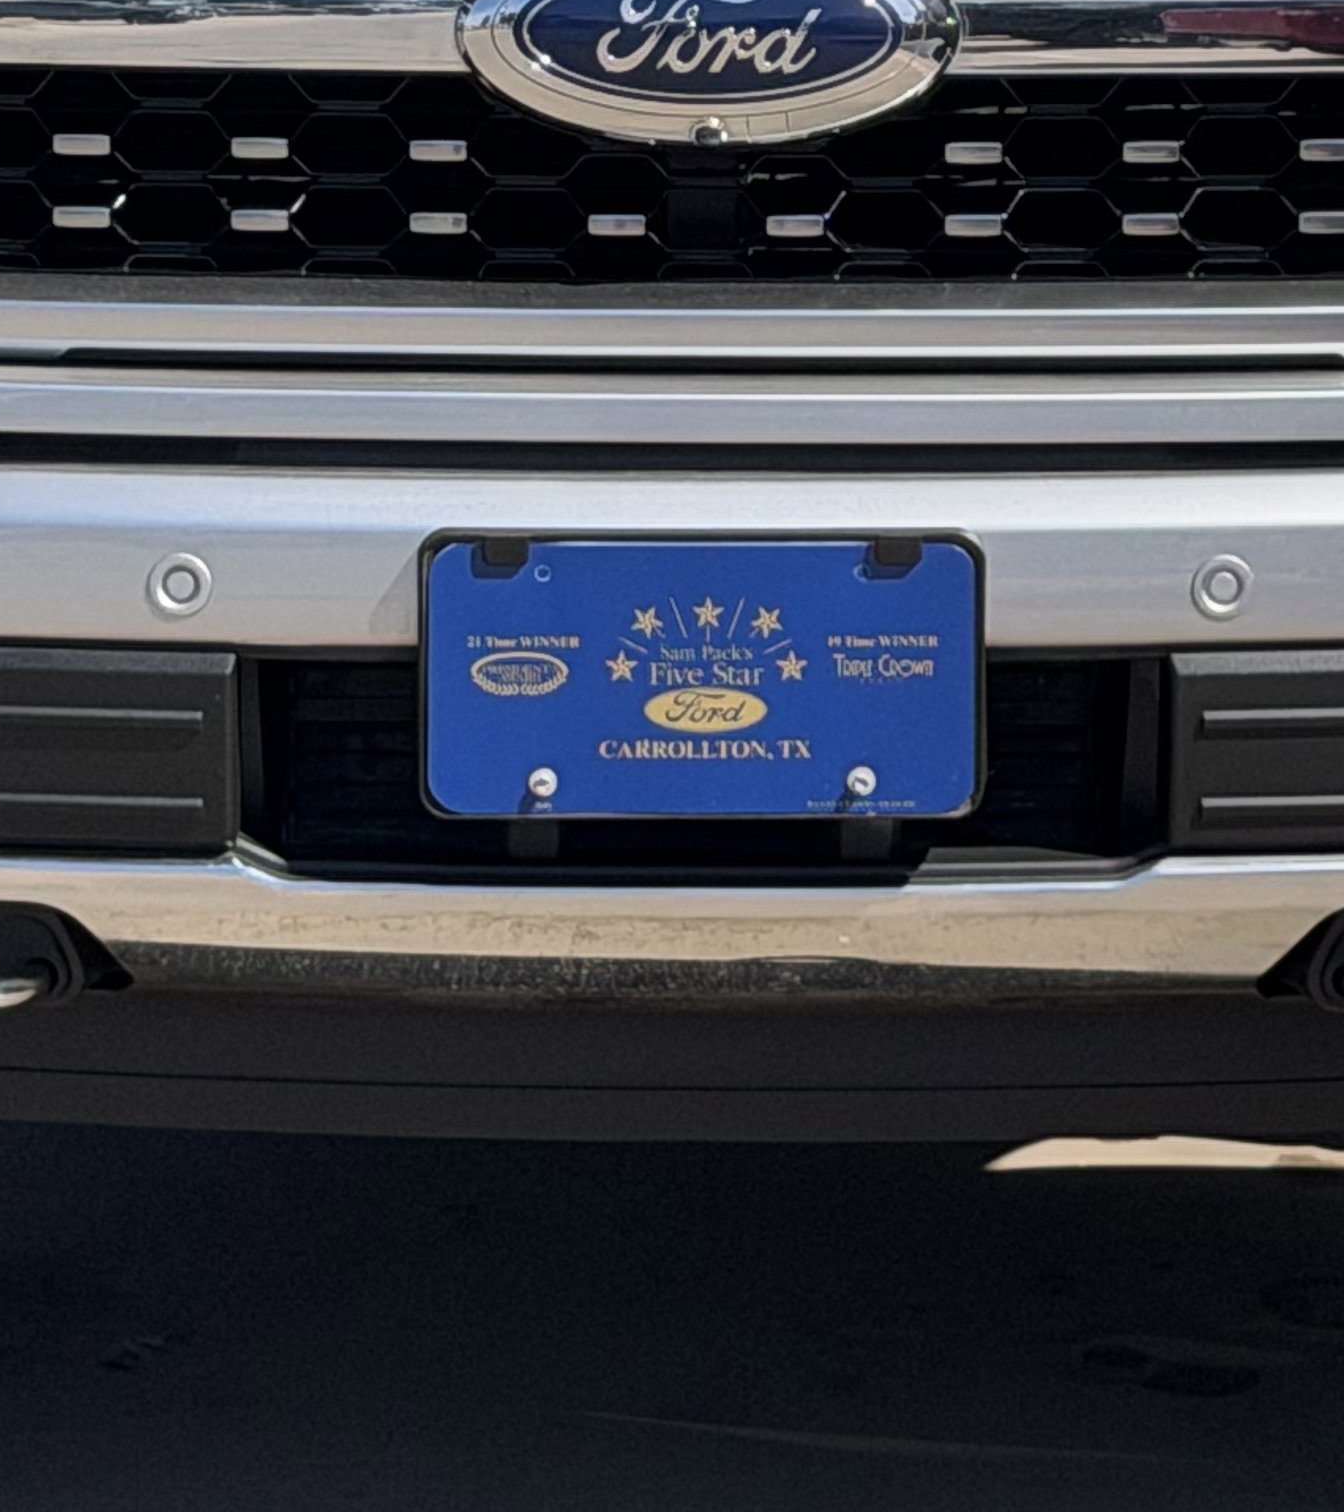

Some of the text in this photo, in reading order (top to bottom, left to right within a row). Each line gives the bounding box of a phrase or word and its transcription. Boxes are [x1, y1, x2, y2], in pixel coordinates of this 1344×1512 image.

[519, 635, 580, 648] WINNER
[878, 635, 938, 648] WINNER
[660, 644, 696, 661] Sam
[649, 660, 765, 686] Five Star
[665, 690, 747, 723] Ford
[598, 739, 812, 760] CARROLLTON, TX
